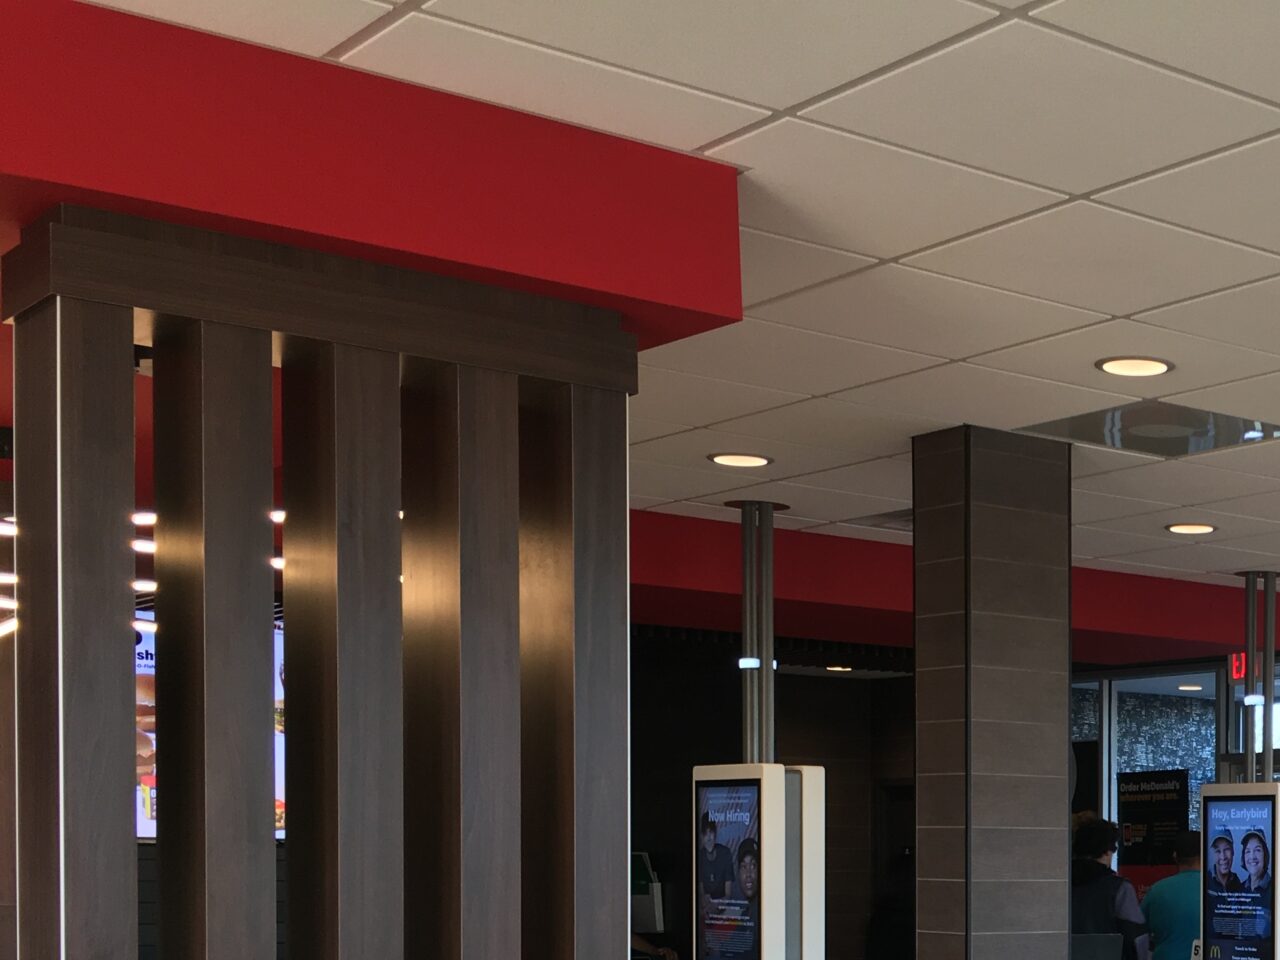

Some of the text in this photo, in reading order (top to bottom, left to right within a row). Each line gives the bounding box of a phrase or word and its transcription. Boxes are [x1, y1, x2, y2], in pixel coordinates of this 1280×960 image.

[1120, 780, 1180, 792] Order McDonald's
[708, 808, 750, 826] Now Hiring
[1211, 807, 1268, 821] Hey, Earlybird
